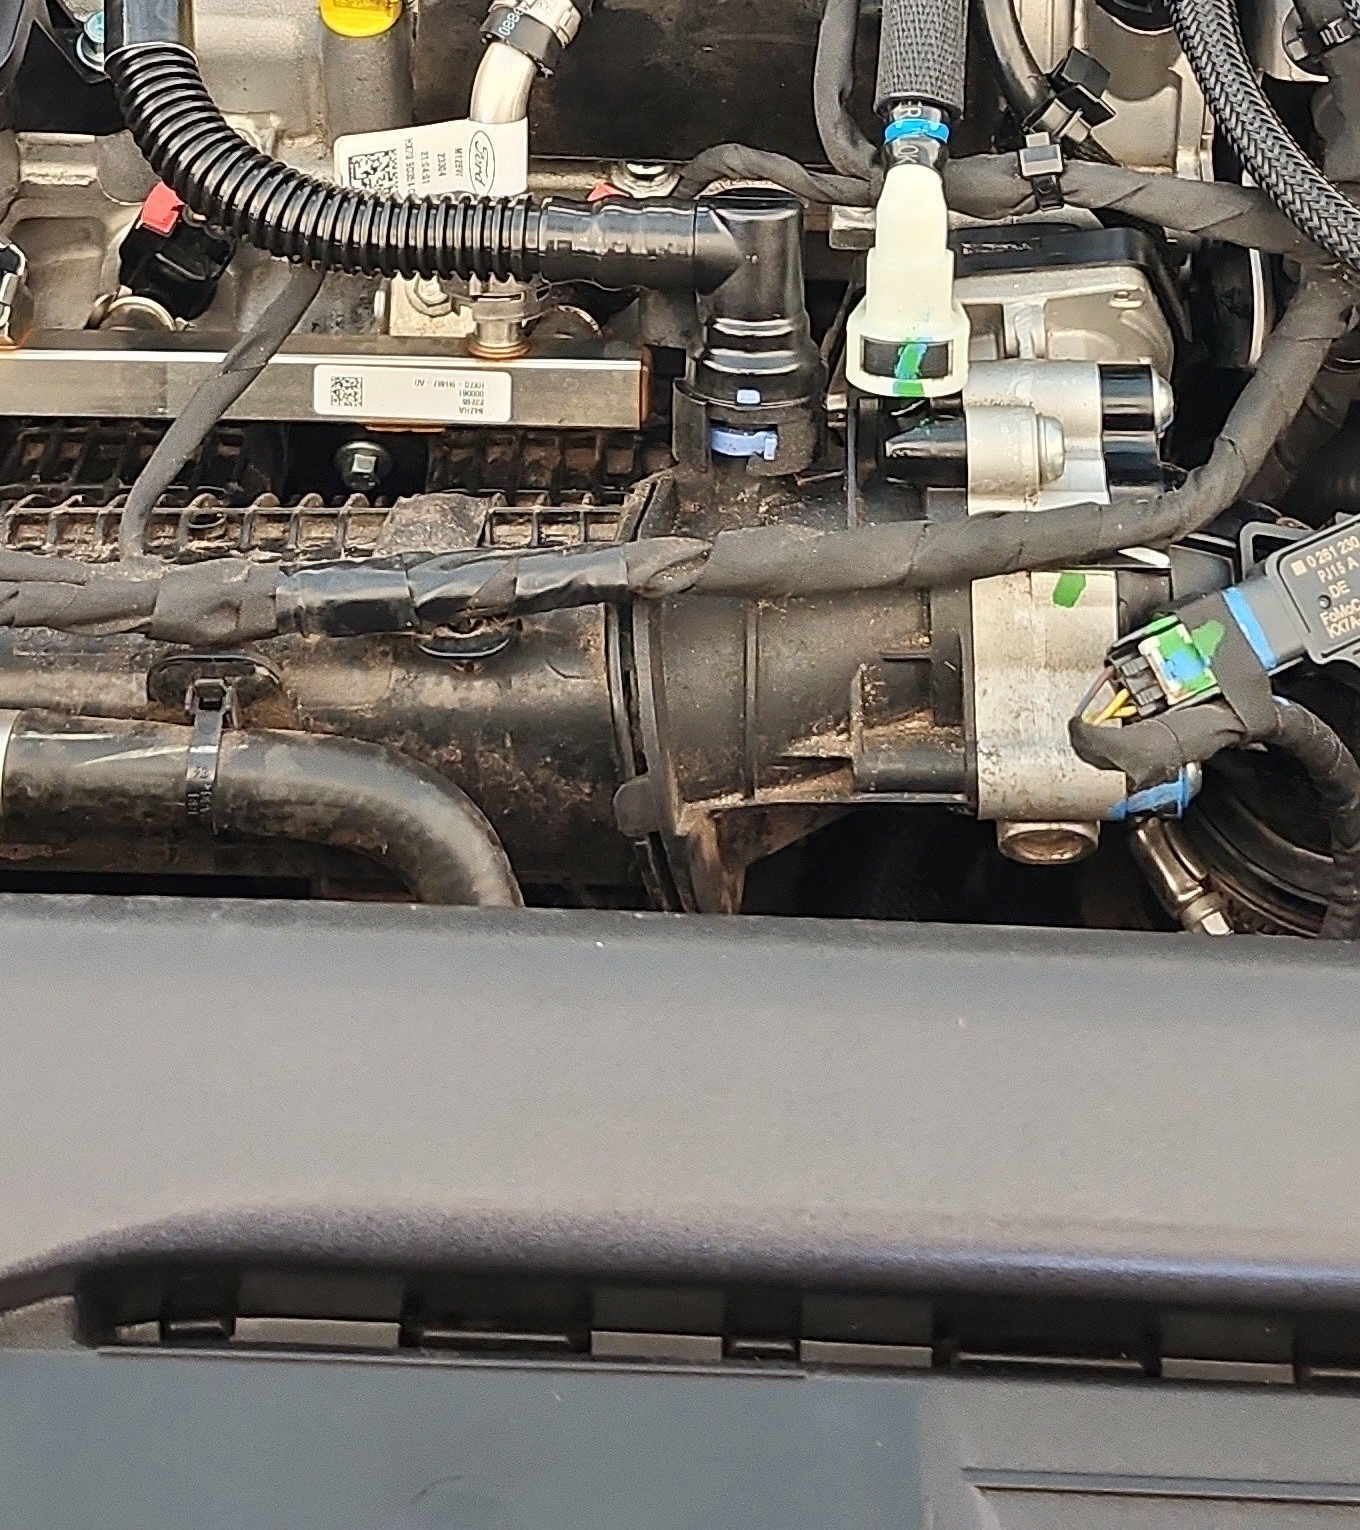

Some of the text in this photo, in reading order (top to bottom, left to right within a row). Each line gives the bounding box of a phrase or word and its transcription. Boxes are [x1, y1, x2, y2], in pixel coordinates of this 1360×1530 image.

[1305, 553, 1317, 568] 0
[1314, 544, 1338, 564] 261
[1335, 533, 1360, 555] 230
[1316, 560, 1346, 584] PJ15
[1344, 554, 1359, 571] A
[1327, 578, 1351, 599] DE
